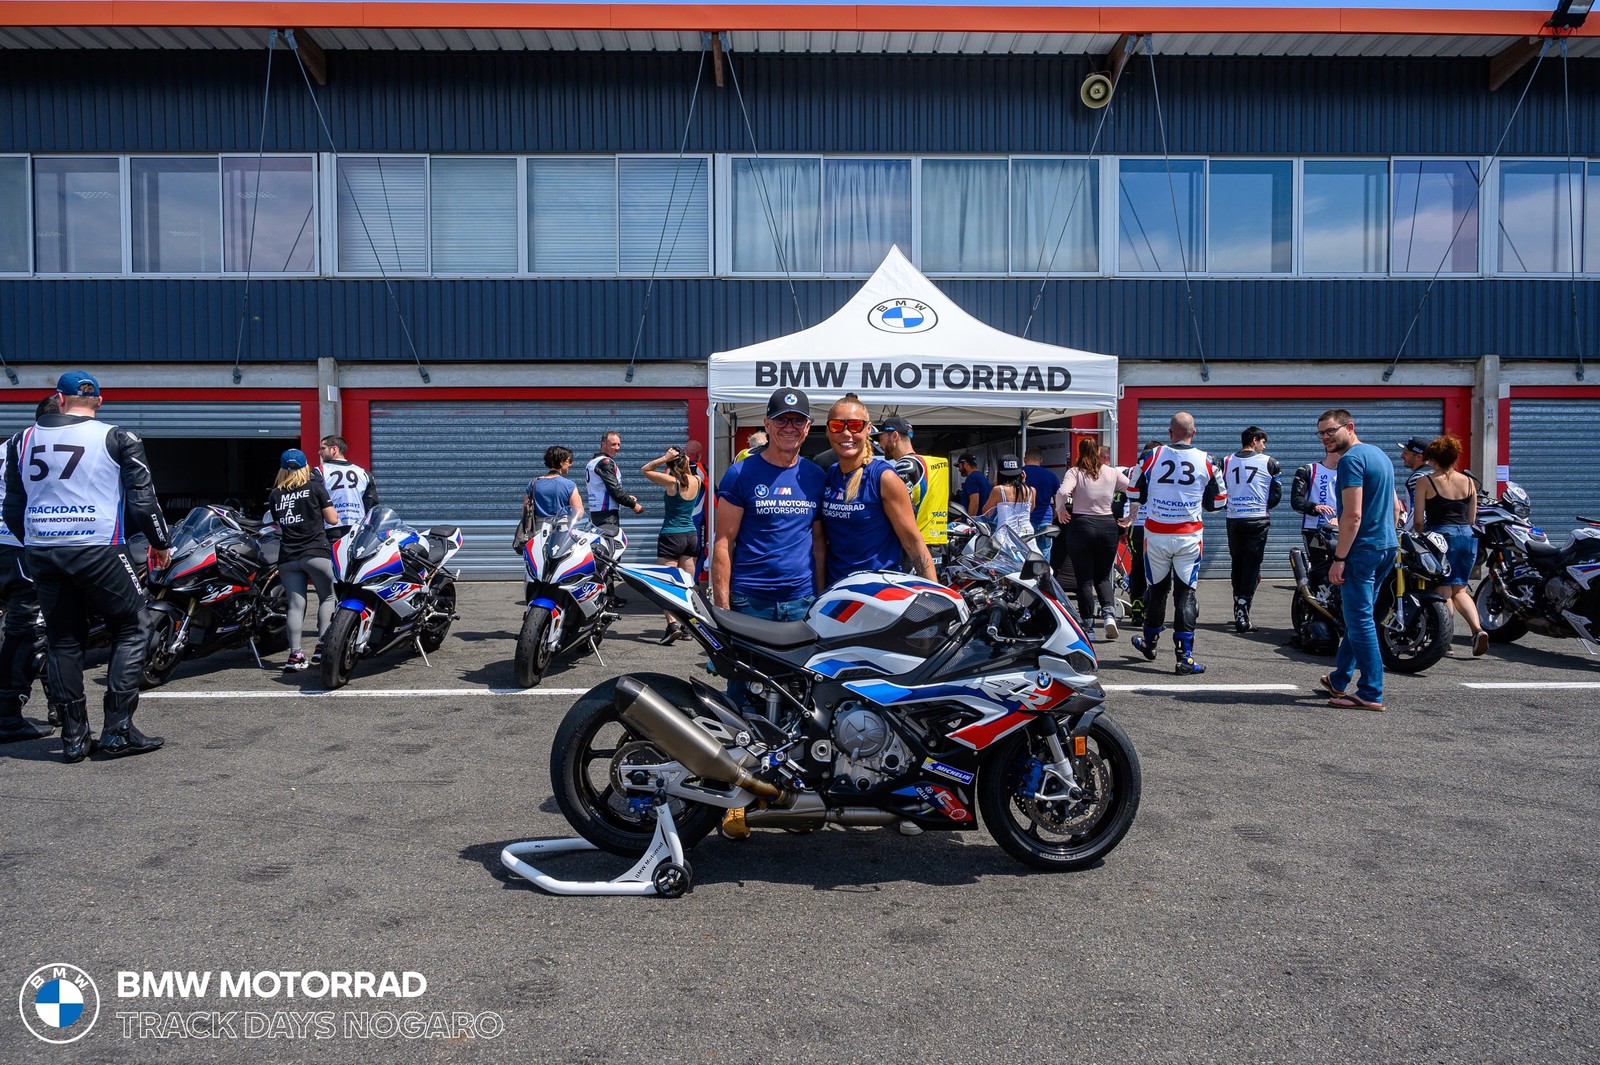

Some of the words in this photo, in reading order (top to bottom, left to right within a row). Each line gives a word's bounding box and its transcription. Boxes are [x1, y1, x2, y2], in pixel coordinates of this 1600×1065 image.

[876, 300, 927, 312] BMW
[755, 361, 849, 388] BMW
[860, 362, 1072, 392] MOTORRAD
[29, 444, 86, 481] 57
[1157, 460, 1196, 485] 23
[1231, 466, 1259, 484] 17
[330, 470, 359, 491] 29
[281, 489, 310, 502] MAKE
[28, 504, 96, 514] TRACKDAYS
[275, 501, 295, 512] LIFE
[756, 506, 810, 515] MOTORSPORT
[779, 500, 817, 509] MOTORRAD
[829, 503, 866, 511] MOTORRAD
[285, 509, 293, 517] A
[823, 509, 852, 519] TORSPORT
[280, 514, 304, 525] RIDE.
[936, 765, 972, 781] MICHELIN
[634, 864, 648, 880] BMW
[645, 841, 664, 866] Motorrad
